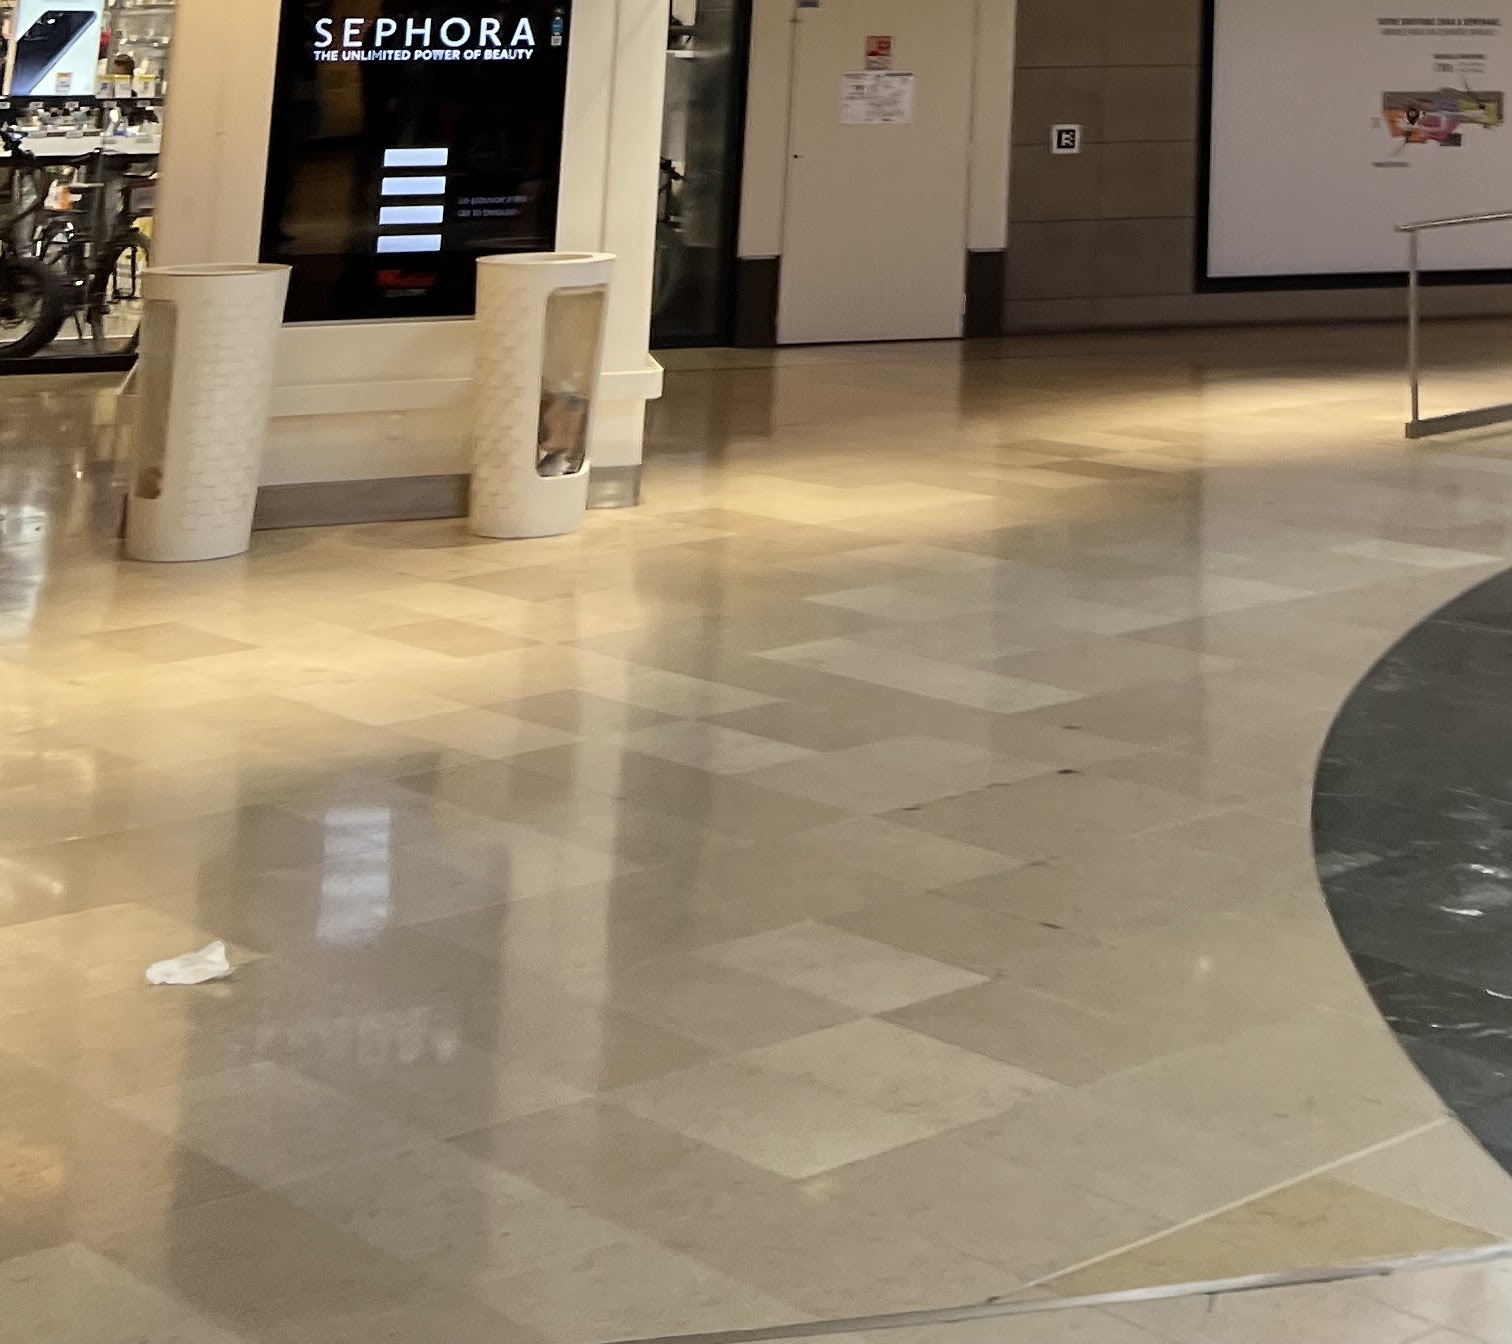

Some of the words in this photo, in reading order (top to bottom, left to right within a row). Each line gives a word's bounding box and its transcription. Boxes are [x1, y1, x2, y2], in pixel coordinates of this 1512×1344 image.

[313, 16, 536, 48] SEPHORA
[313, 49, 339, 62] THE
[341, 49, 411, 62] UNLIMITED
[413, 49, 460, 62] POWER
[463, 48, 481, 60] OF
[483, 48, 534, 60] BEAUTY
